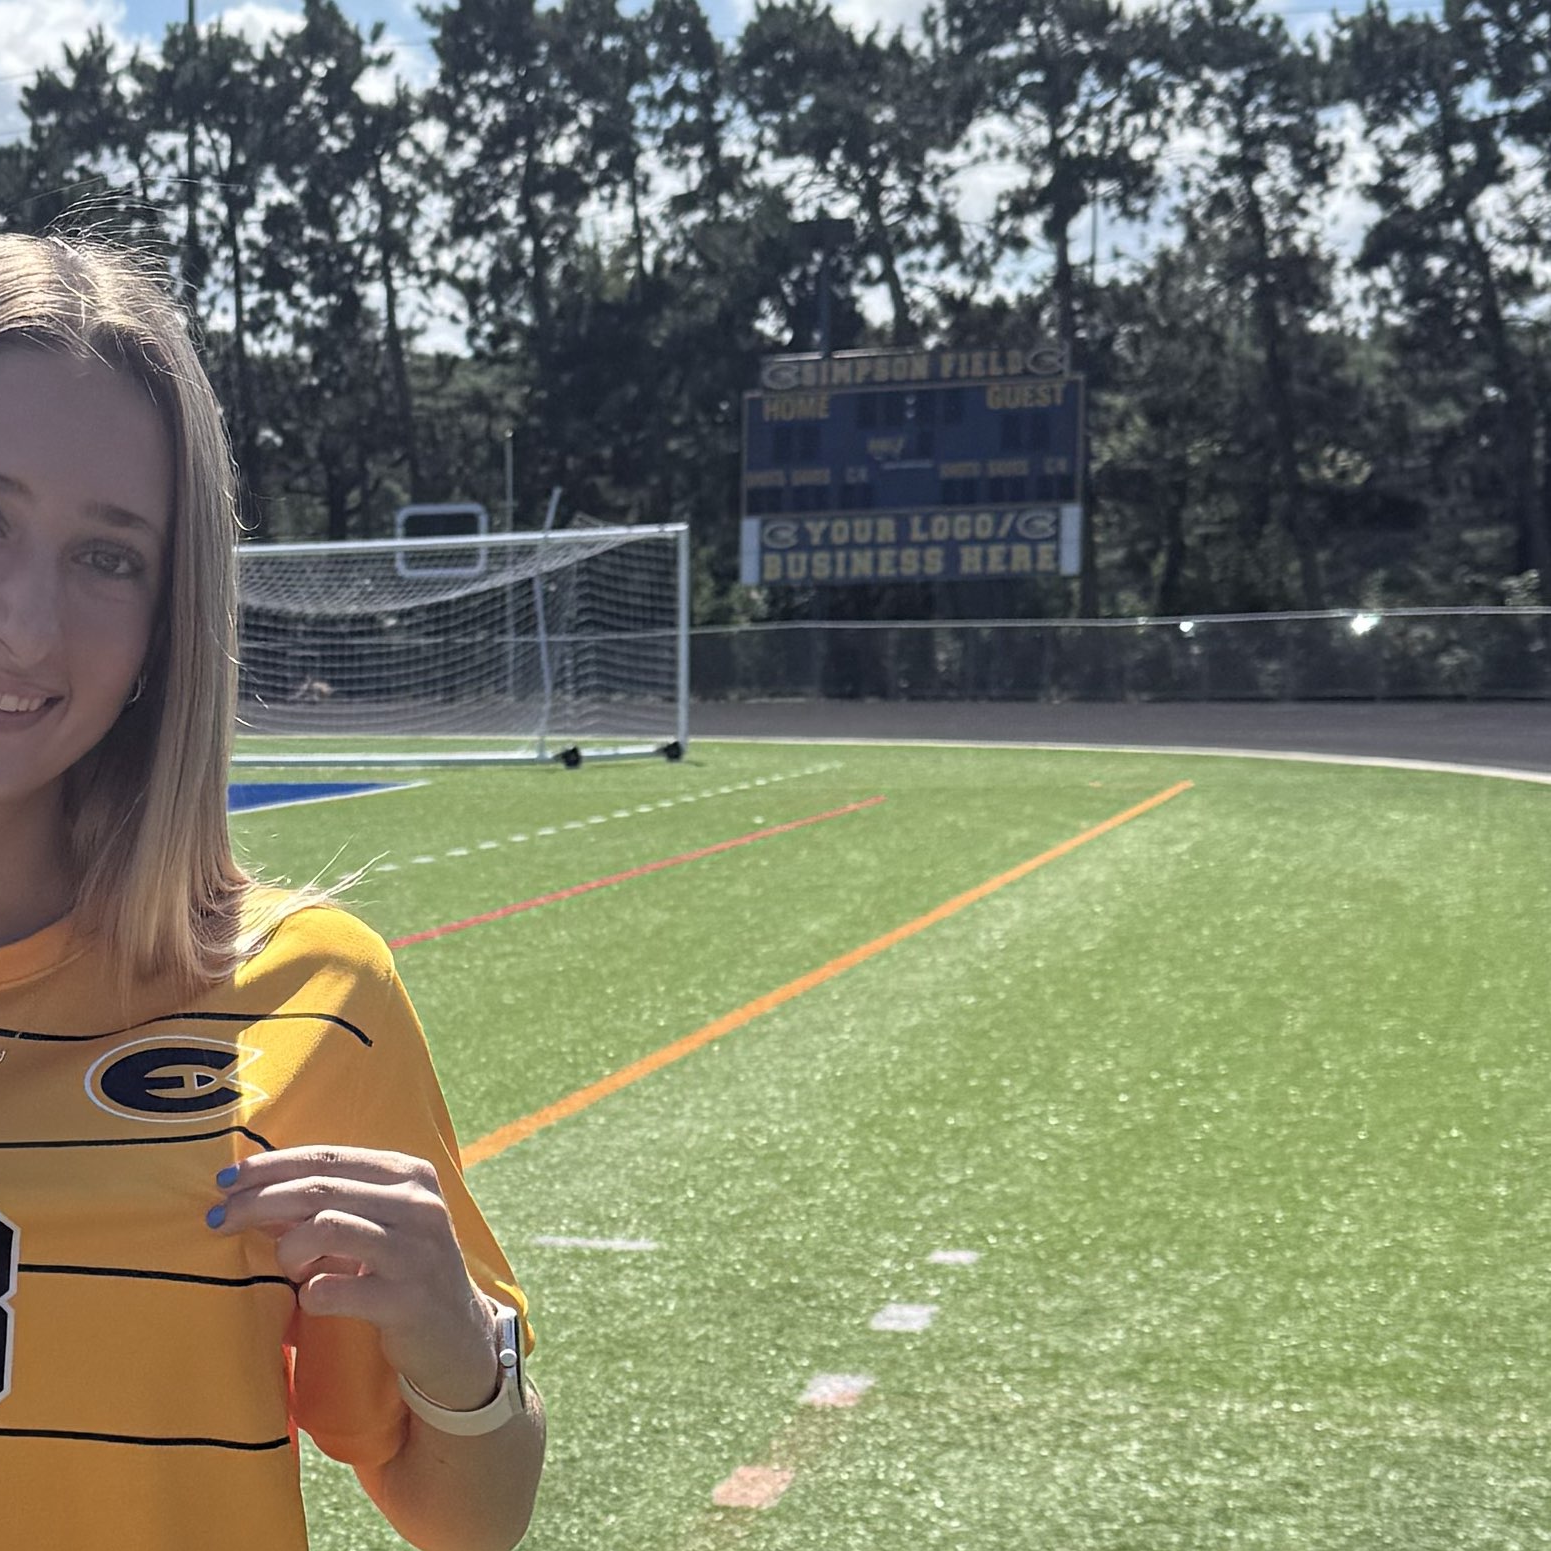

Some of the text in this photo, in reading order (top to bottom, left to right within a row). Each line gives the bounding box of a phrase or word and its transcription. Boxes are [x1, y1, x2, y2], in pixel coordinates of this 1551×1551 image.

[801, 349, 1023, 386] SIMPSON FIELD
[762, 393, 830, 421] HOME
[986, 383, 1066, 410] GUEST
[804, 516, 897, 547] YOUR
[762, 542, 1058, 582] BUSINESS HERE
